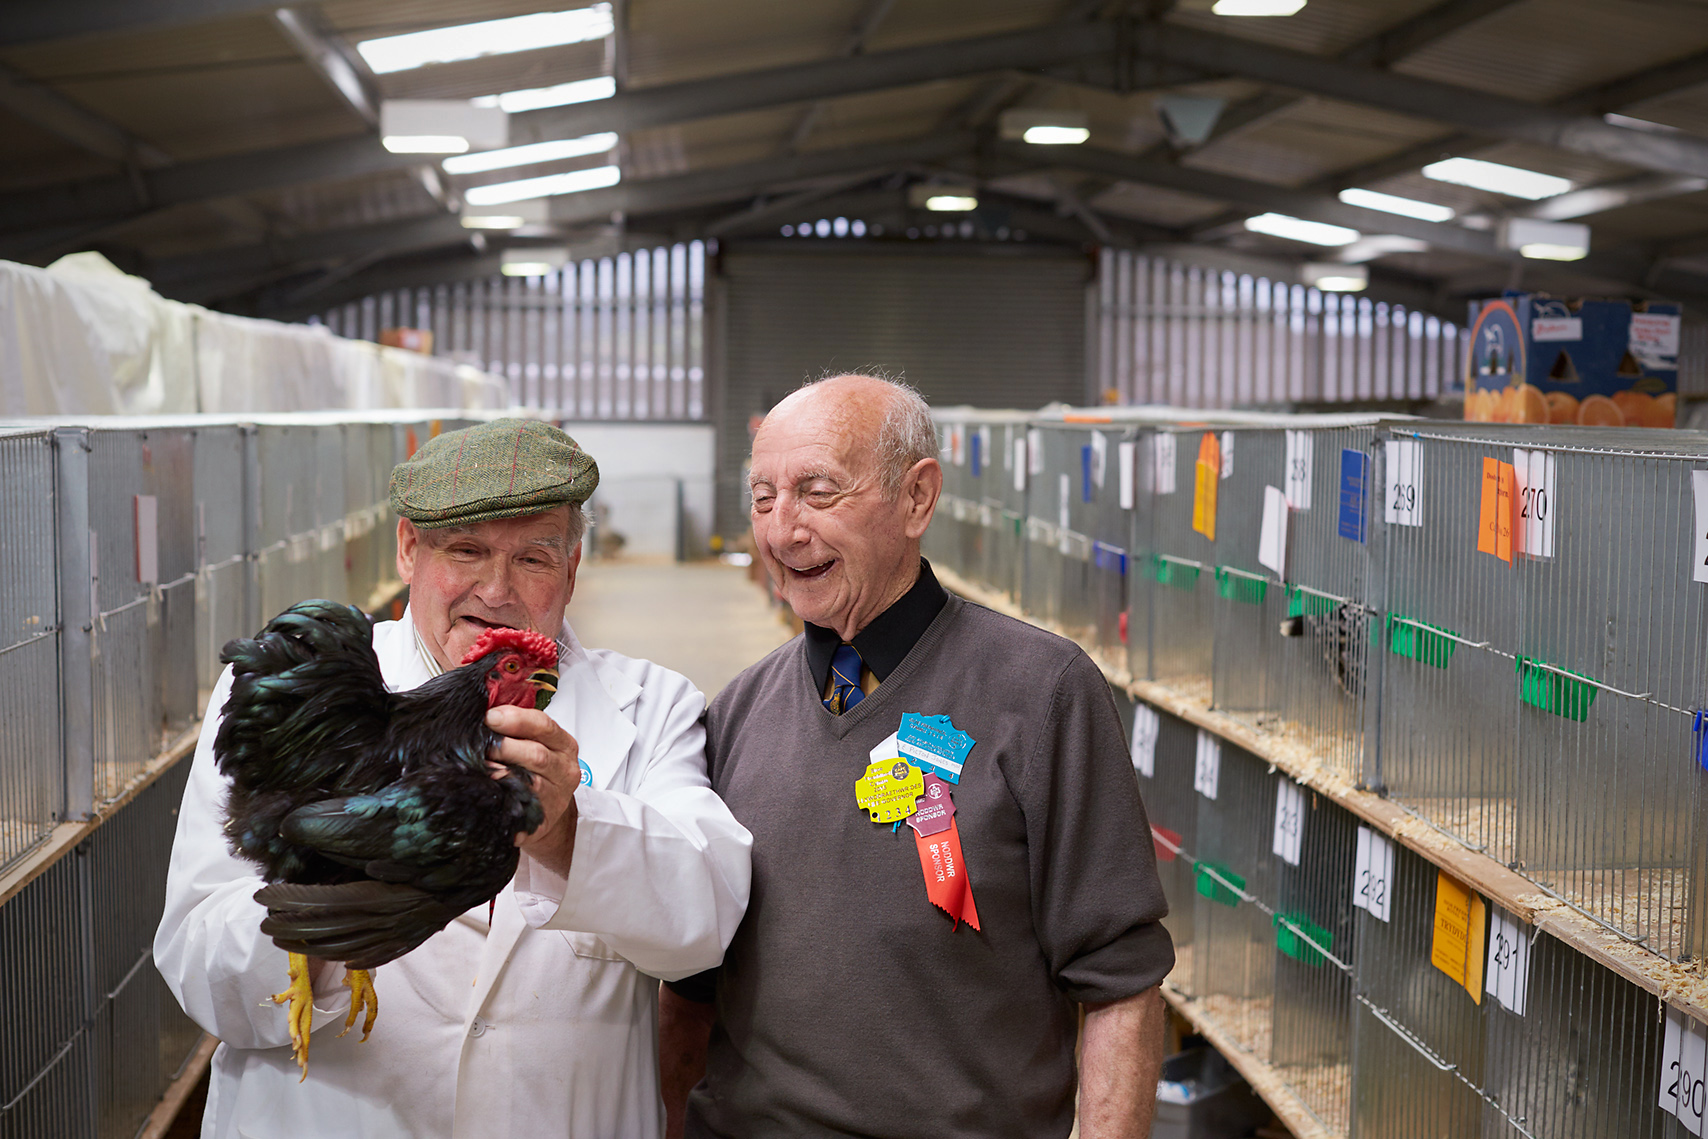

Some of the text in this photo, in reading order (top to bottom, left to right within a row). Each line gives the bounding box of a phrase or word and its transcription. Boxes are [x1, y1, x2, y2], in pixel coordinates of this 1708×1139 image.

[1291, 458, 1305, 482] 28
[1521, 486, 1548, 521] 270
[881, 792, 914, 804] GOVERNOR
[885, 810, 892, 820] 2
[895, 807, 902, 817] 3
[905, 805, 911, 814] 4
[916, 809, 946, 823] SPONSOR
[929, 843, 946, 883] SPONSOR
[940, 840, 956, 878] NODDWR
[1440, 917, 1469, 945] TRYDYD
[1494, 932, 1518, 971] 29
[1668, 1060, 1706, 1118] 290
